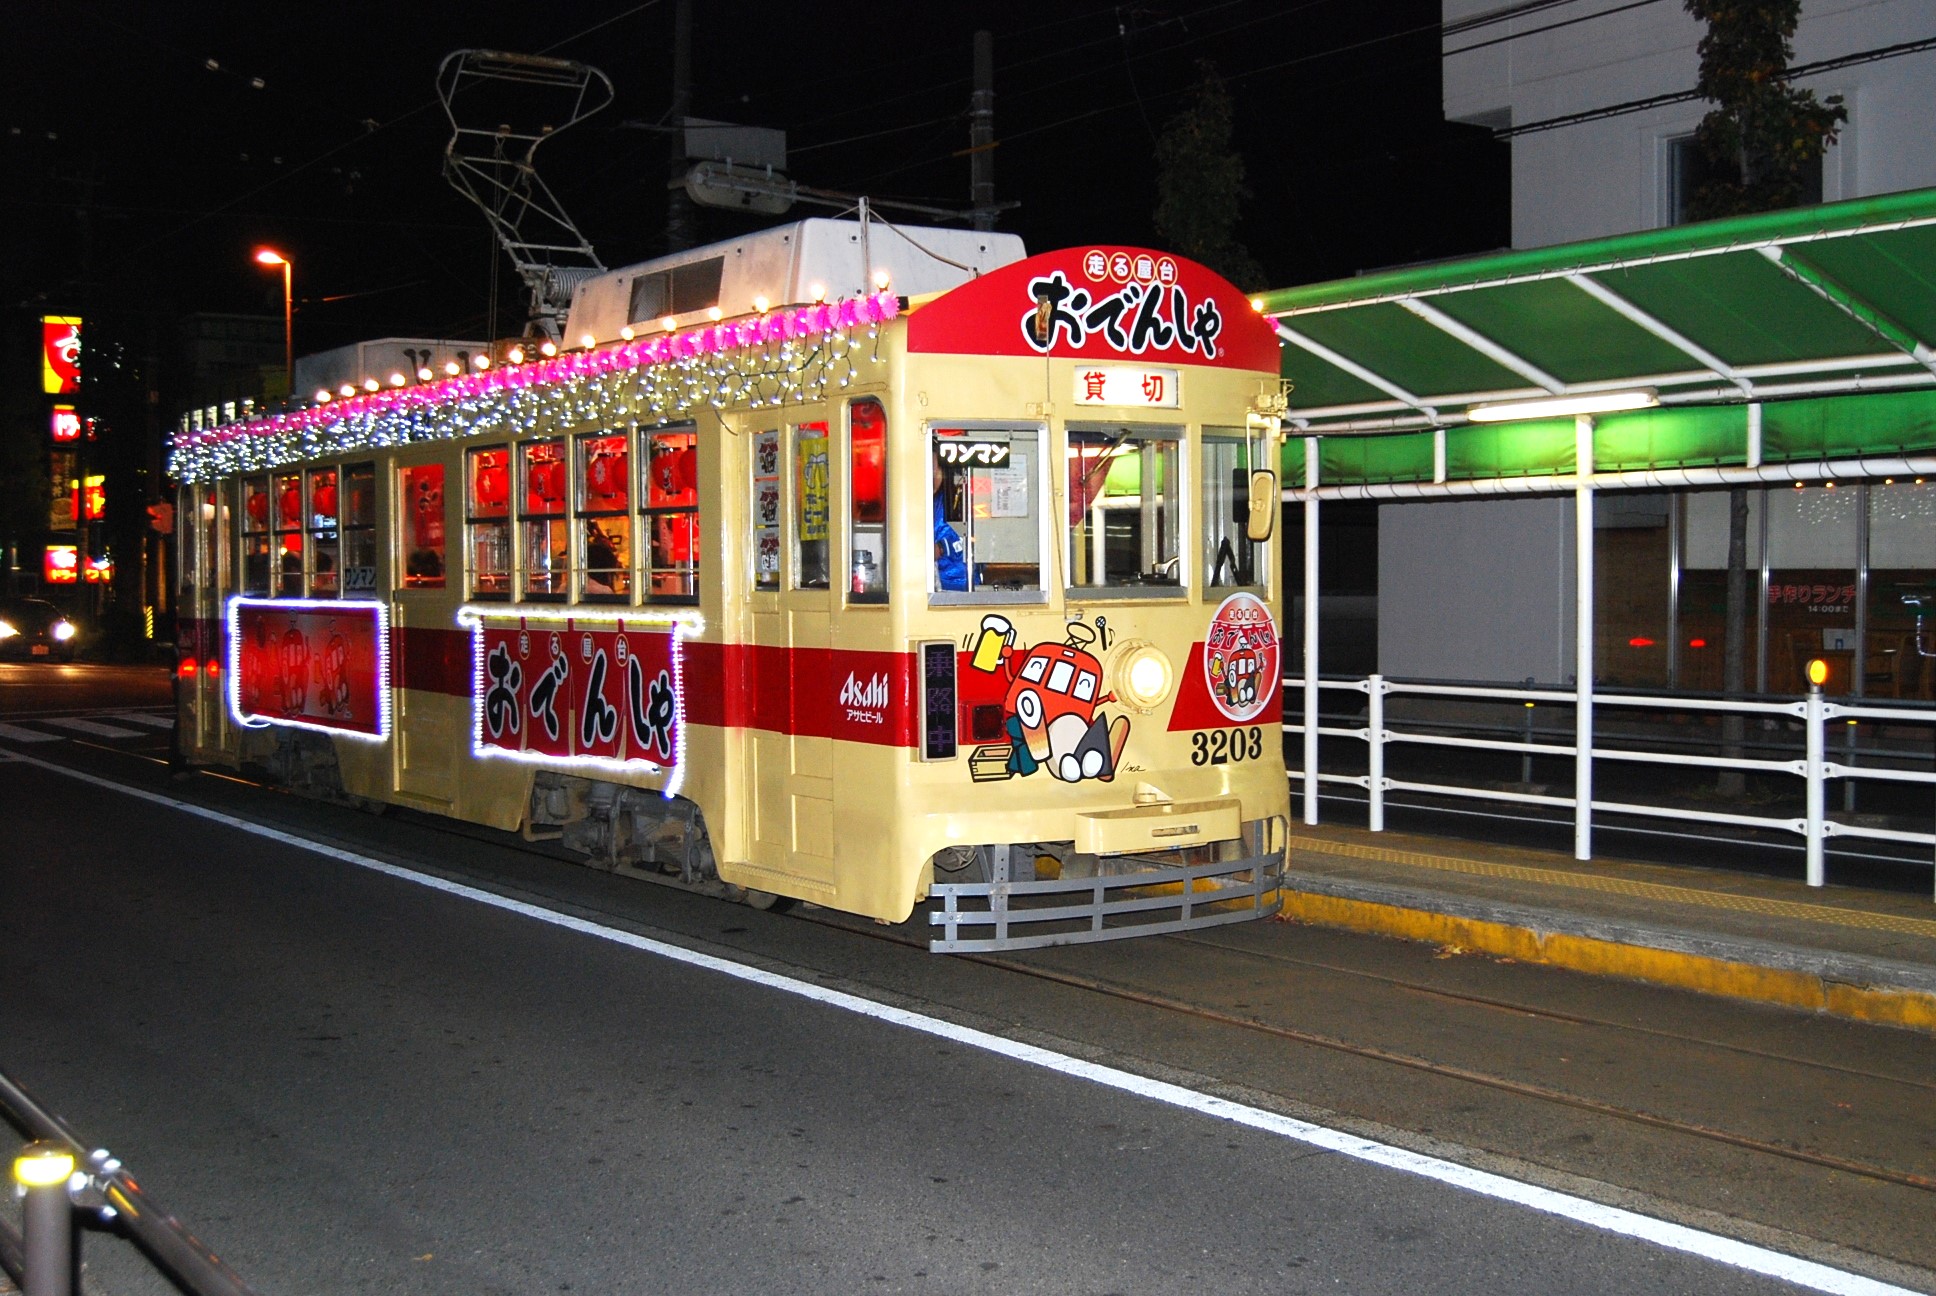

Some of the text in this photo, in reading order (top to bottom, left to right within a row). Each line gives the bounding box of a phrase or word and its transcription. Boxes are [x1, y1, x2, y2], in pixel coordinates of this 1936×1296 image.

[1087, 254, 1176, 282] 走る屋台
[1022, 271, 1222, 359] おでんしゃ
[940, 443, 1009, 464] ワンマン
[1768, 584, 1856, 604] 手作りランチ
[519, 633, 627, 660] 走る屋台
[487, 641, 675, 759] おでんしゃ
[839, 670, 889, 709] Asahi
[846, 709, 884, 724] アサヒビール
[1191, 727, 1263, 766] 3203
